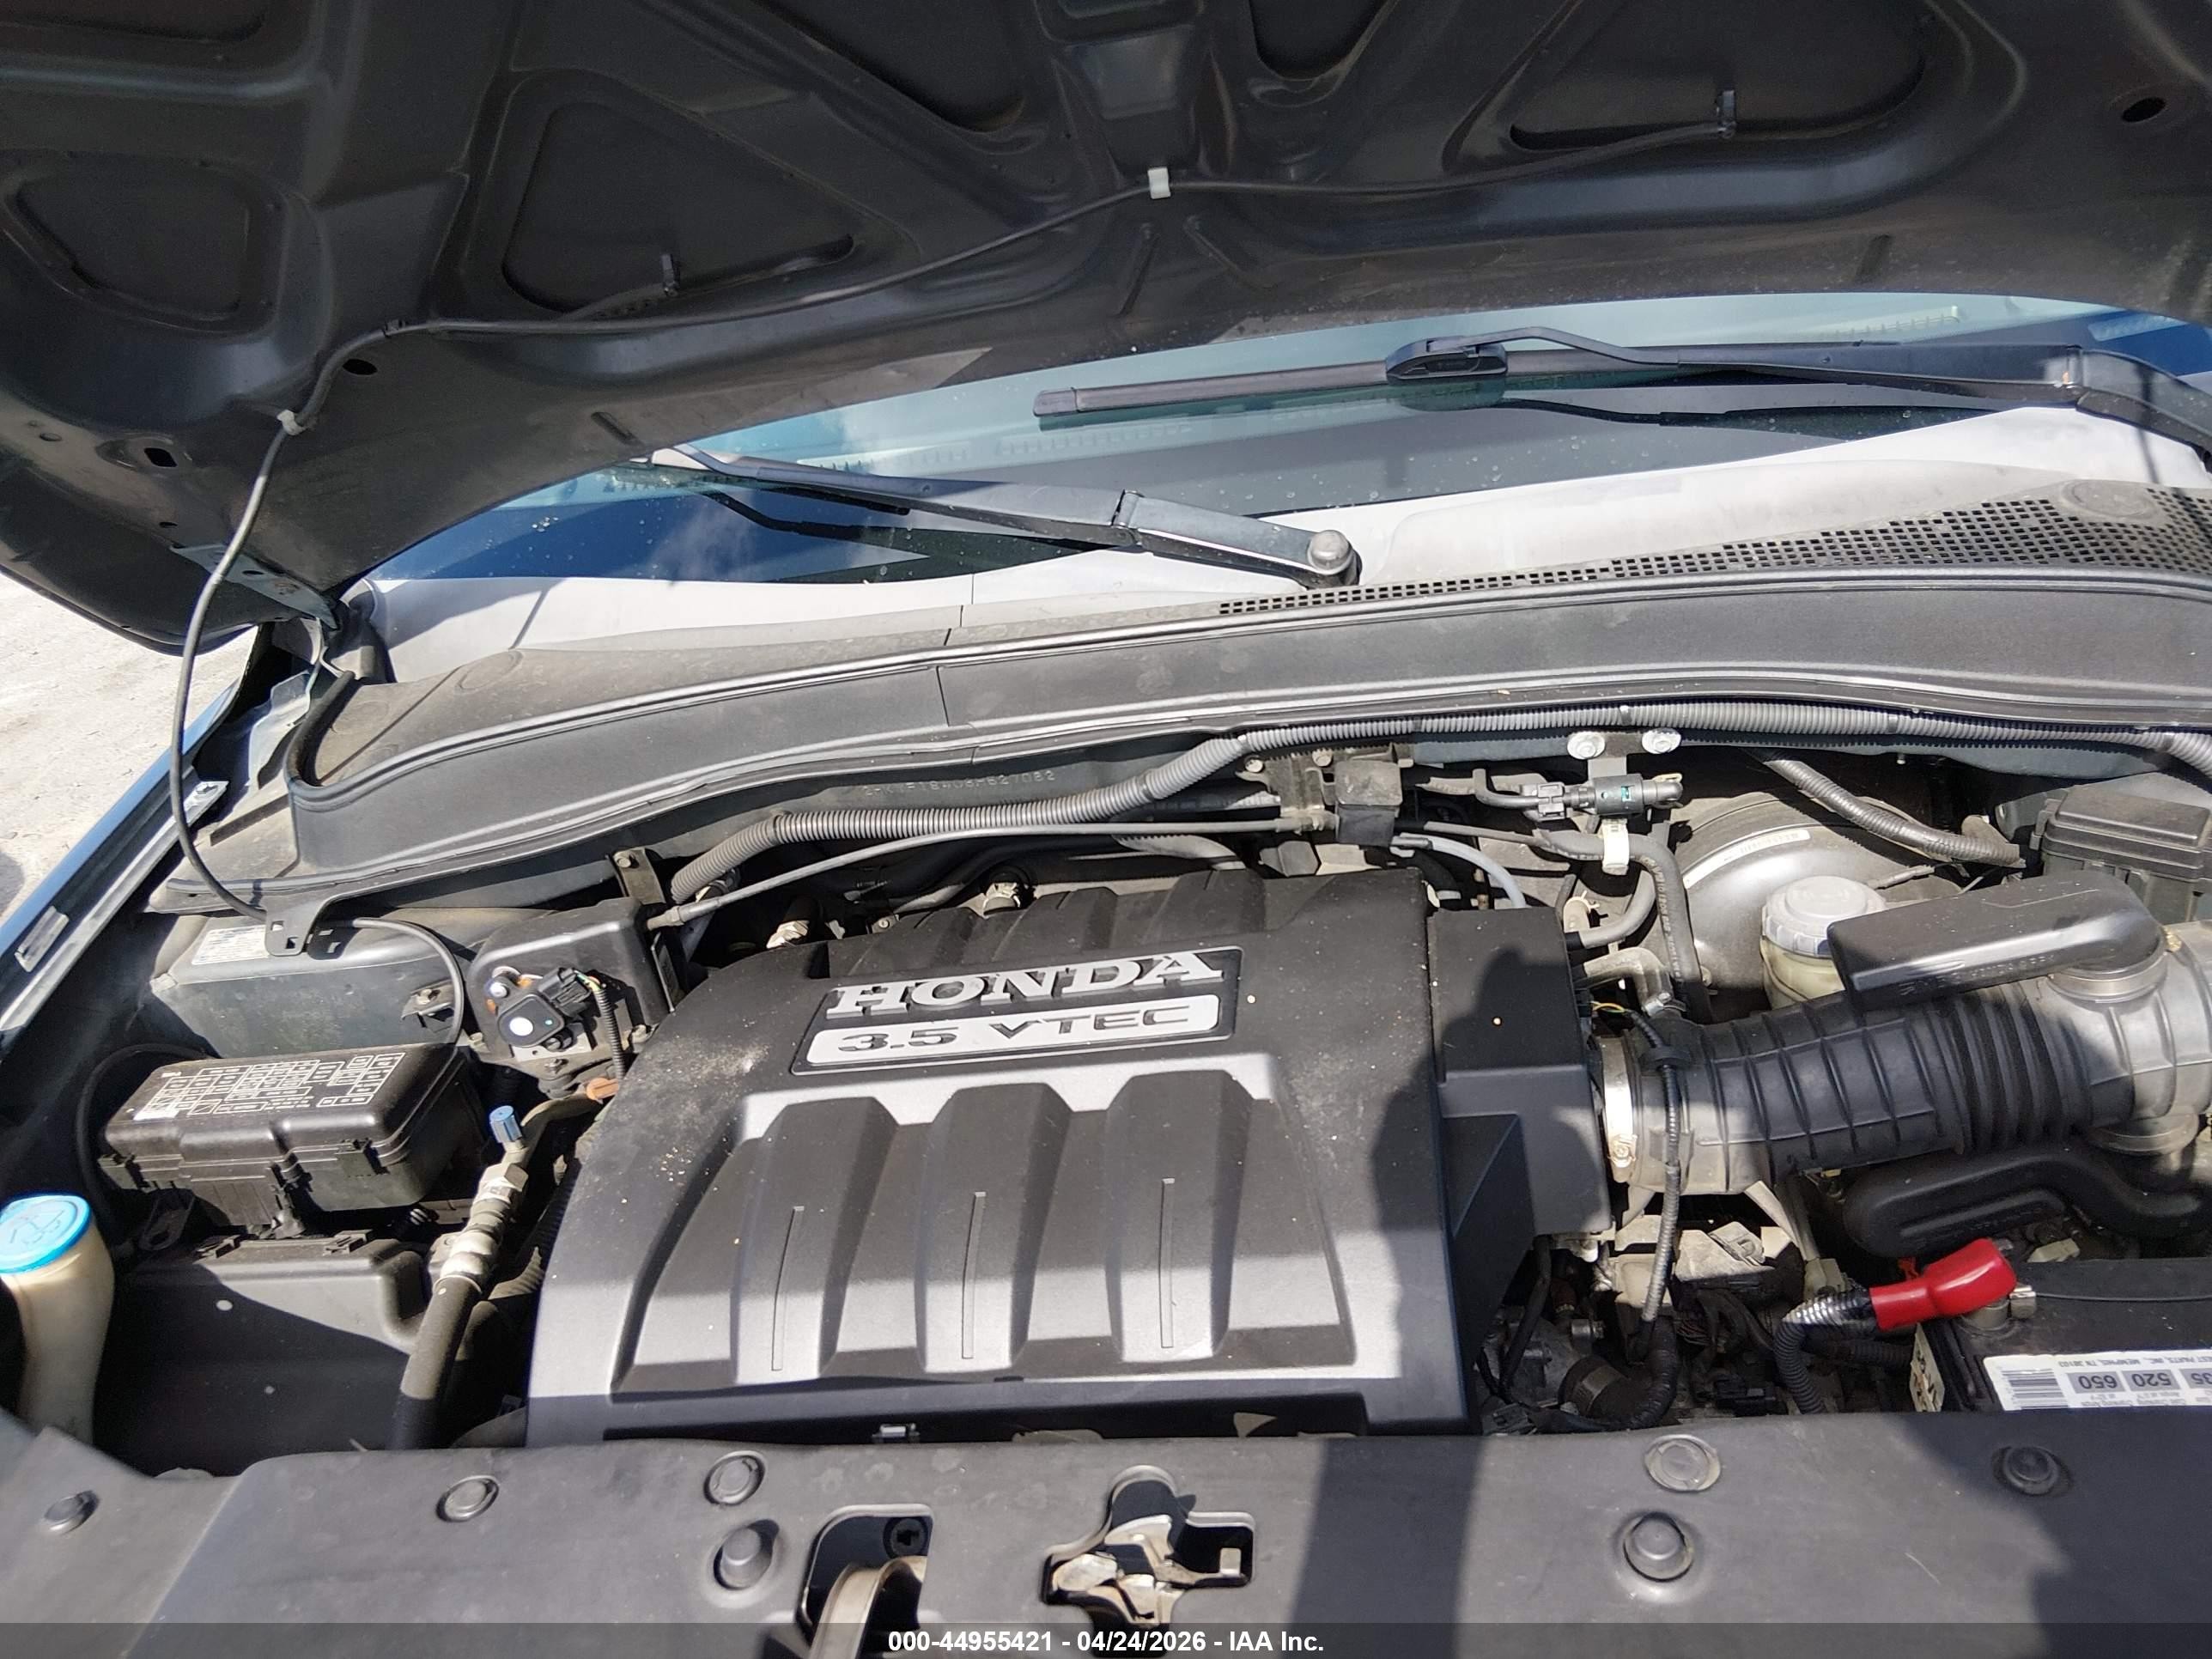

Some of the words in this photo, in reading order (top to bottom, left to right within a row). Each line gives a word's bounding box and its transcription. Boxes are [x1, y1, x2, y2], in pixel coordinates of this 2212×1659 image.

[827, 951, 1223, 1019] HONDA
[838, 1028, 959, 1052] 3.5
[988, 1006, 1191, 1039] VTEC
[2078, 1375, 2118, 1389] 650
[2132, 1373, 2172, 1388] 520
